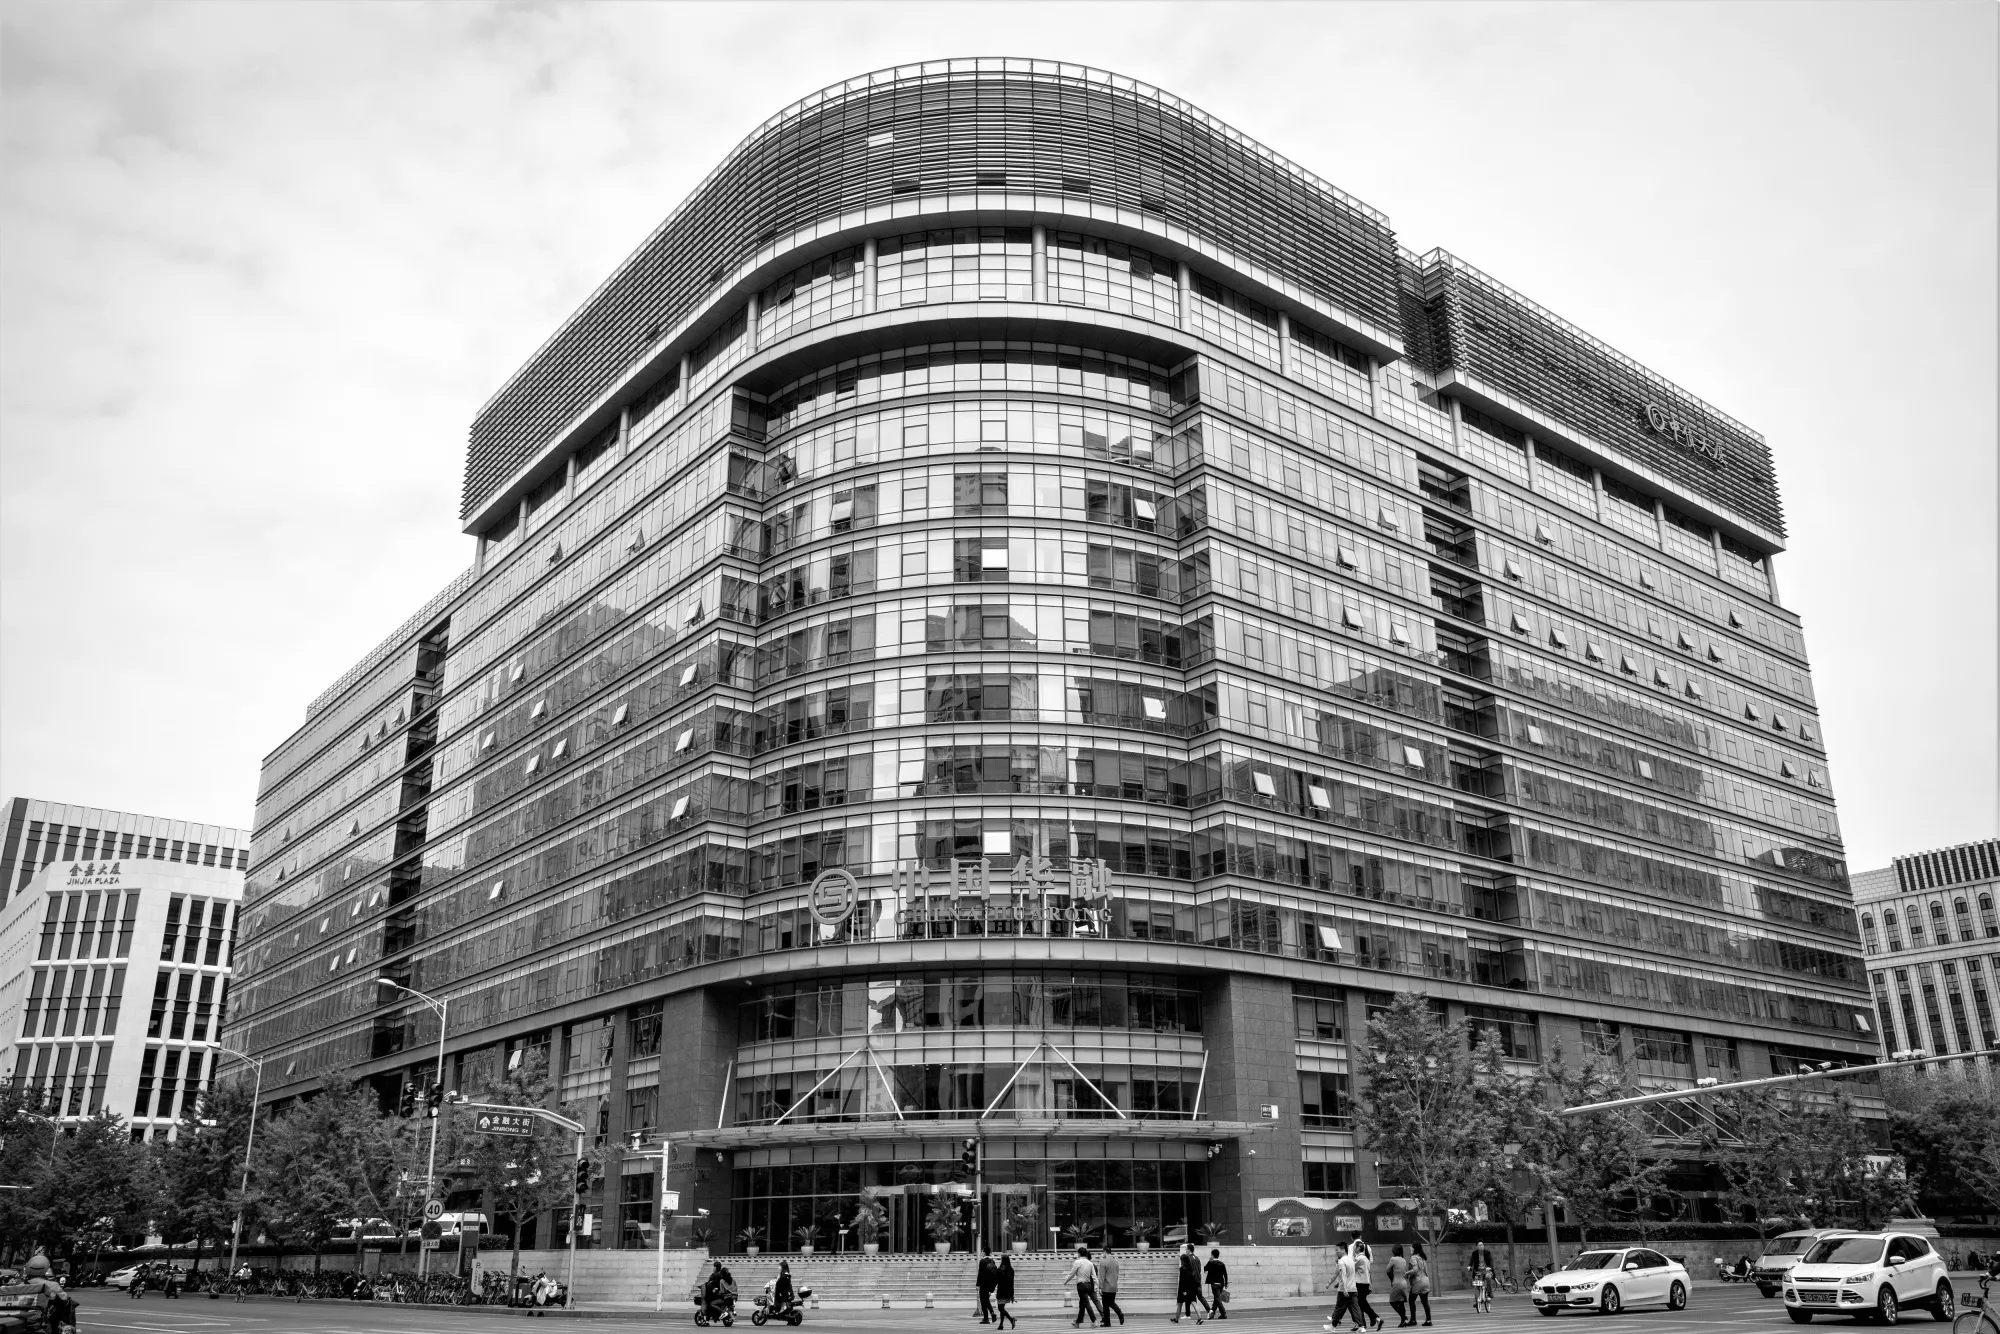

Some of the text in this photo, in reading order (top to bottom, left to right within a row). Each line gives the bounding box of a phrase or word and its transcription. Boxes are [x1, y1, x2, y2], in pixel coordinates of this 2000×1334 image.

[69, 862, 121, 877] 金嘉大厦
[67, 877, 120, 885] JINJIA PLAZA
[892, 855, 1115, 904] 中国华融
[894, 906, 1114, 924] CHINA HUARONG
[492, 1115, 530, 1127] 金融大街
[427, 1204, 440, 1215] 40
